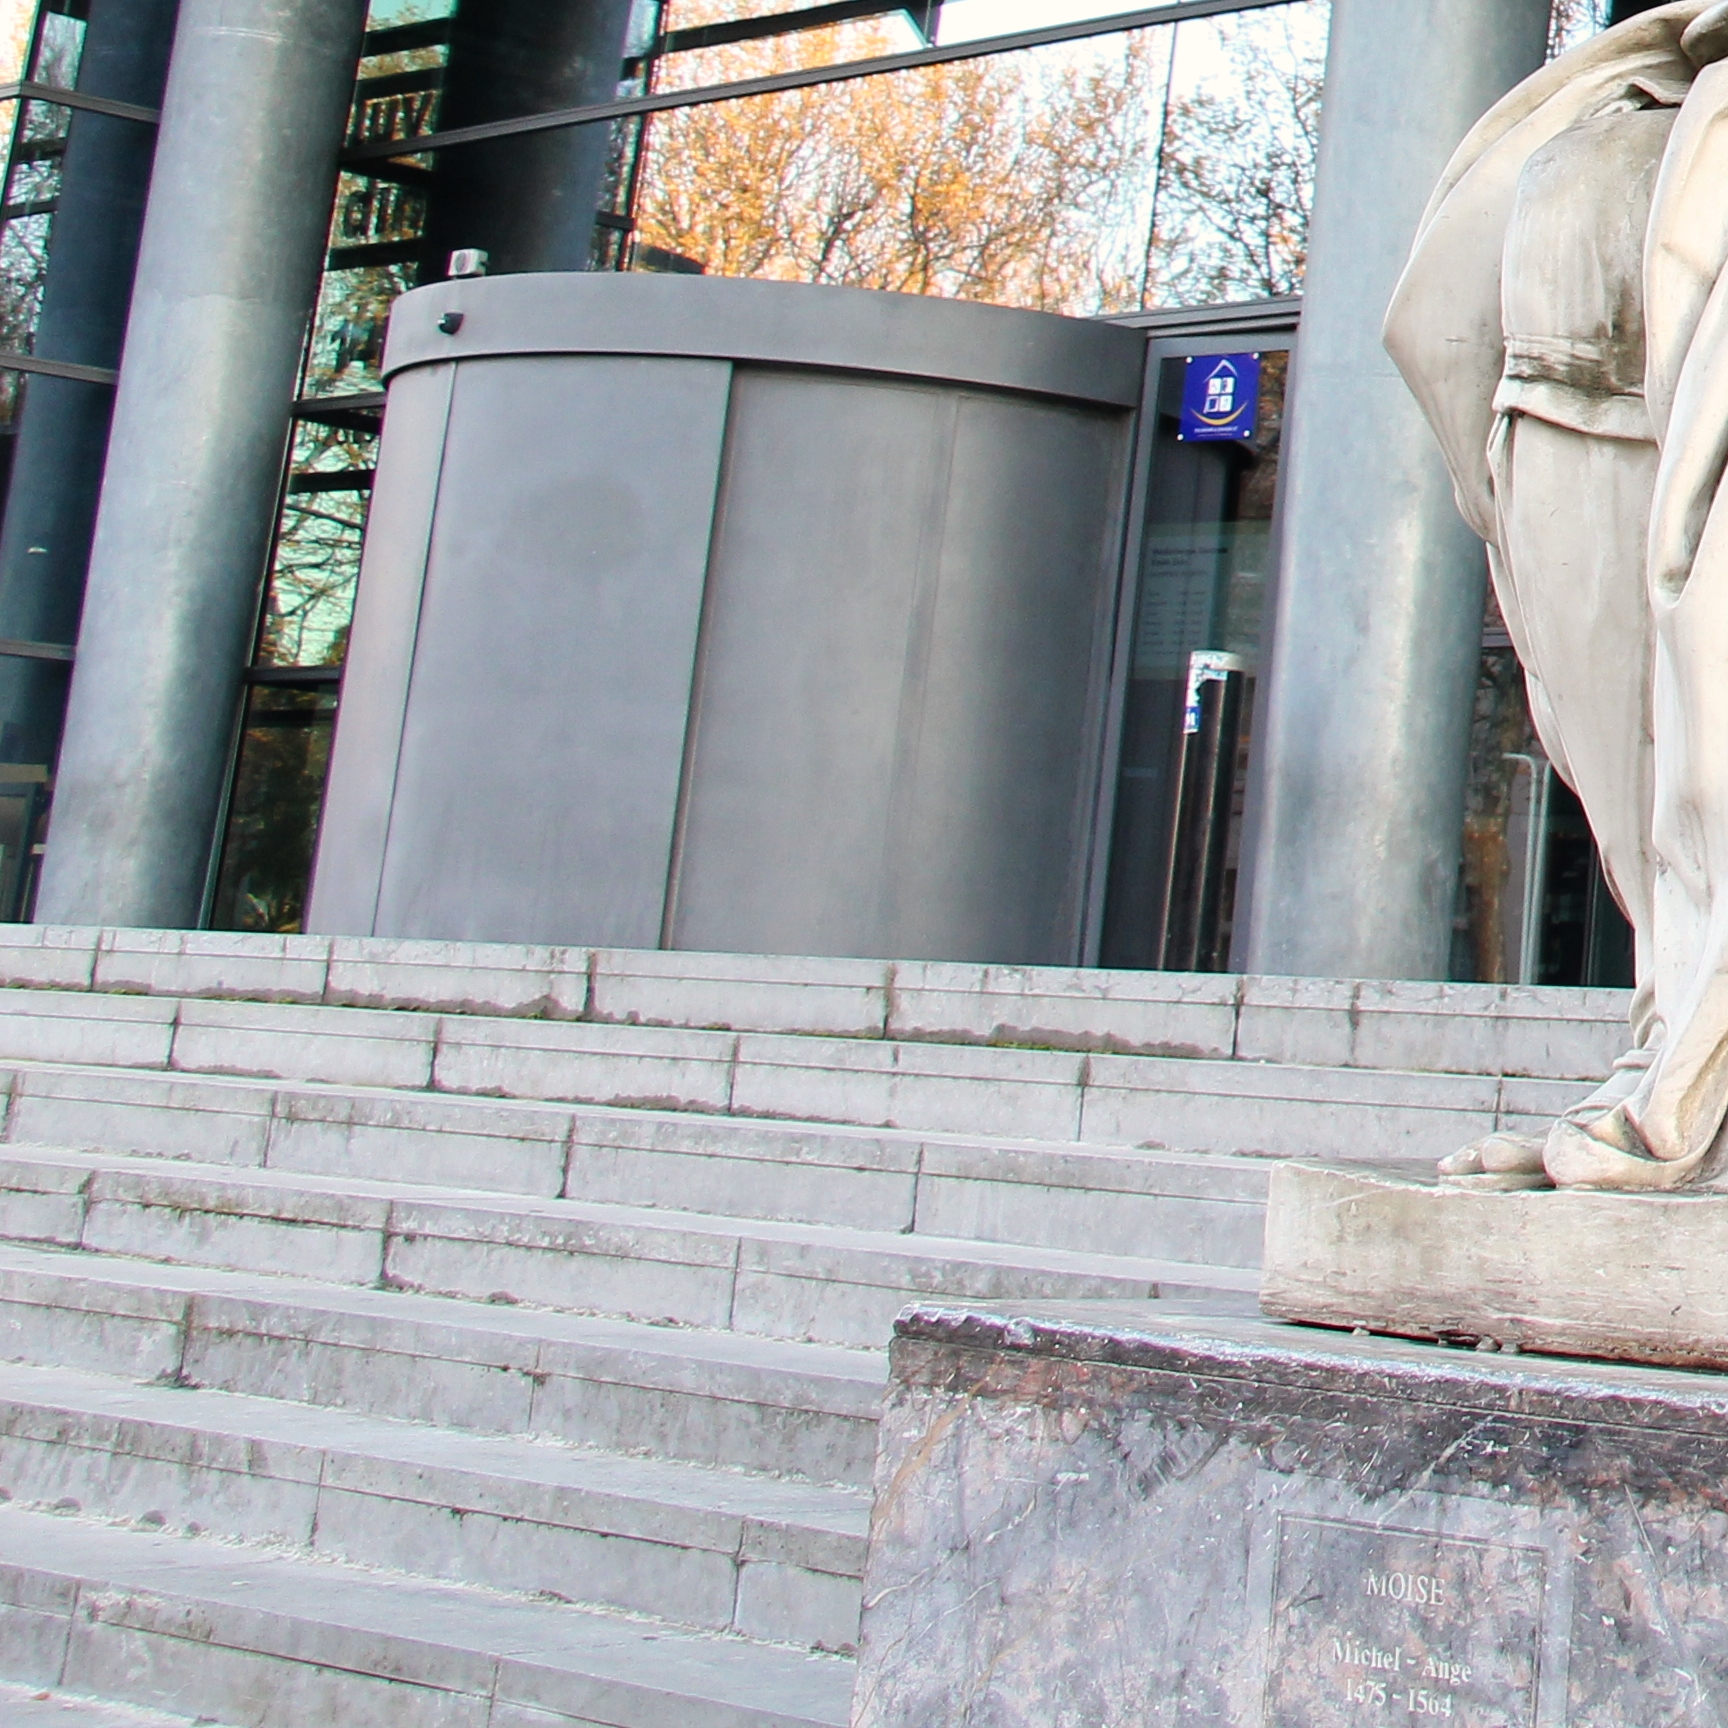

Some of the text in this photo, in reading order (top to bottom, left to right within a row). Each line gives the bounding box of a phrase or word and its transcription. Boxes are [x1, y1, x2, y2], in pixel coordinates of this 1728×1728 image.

[1365, 1570, 1445, 1605] MOISE
[1332, 1637, 1401, 1671] Michel
[1421, 1656, 1472, 1686] Ange
[1345, 1678, 1387, 1707] 1475
[1408, 1687, 1453, 1718] 1564
